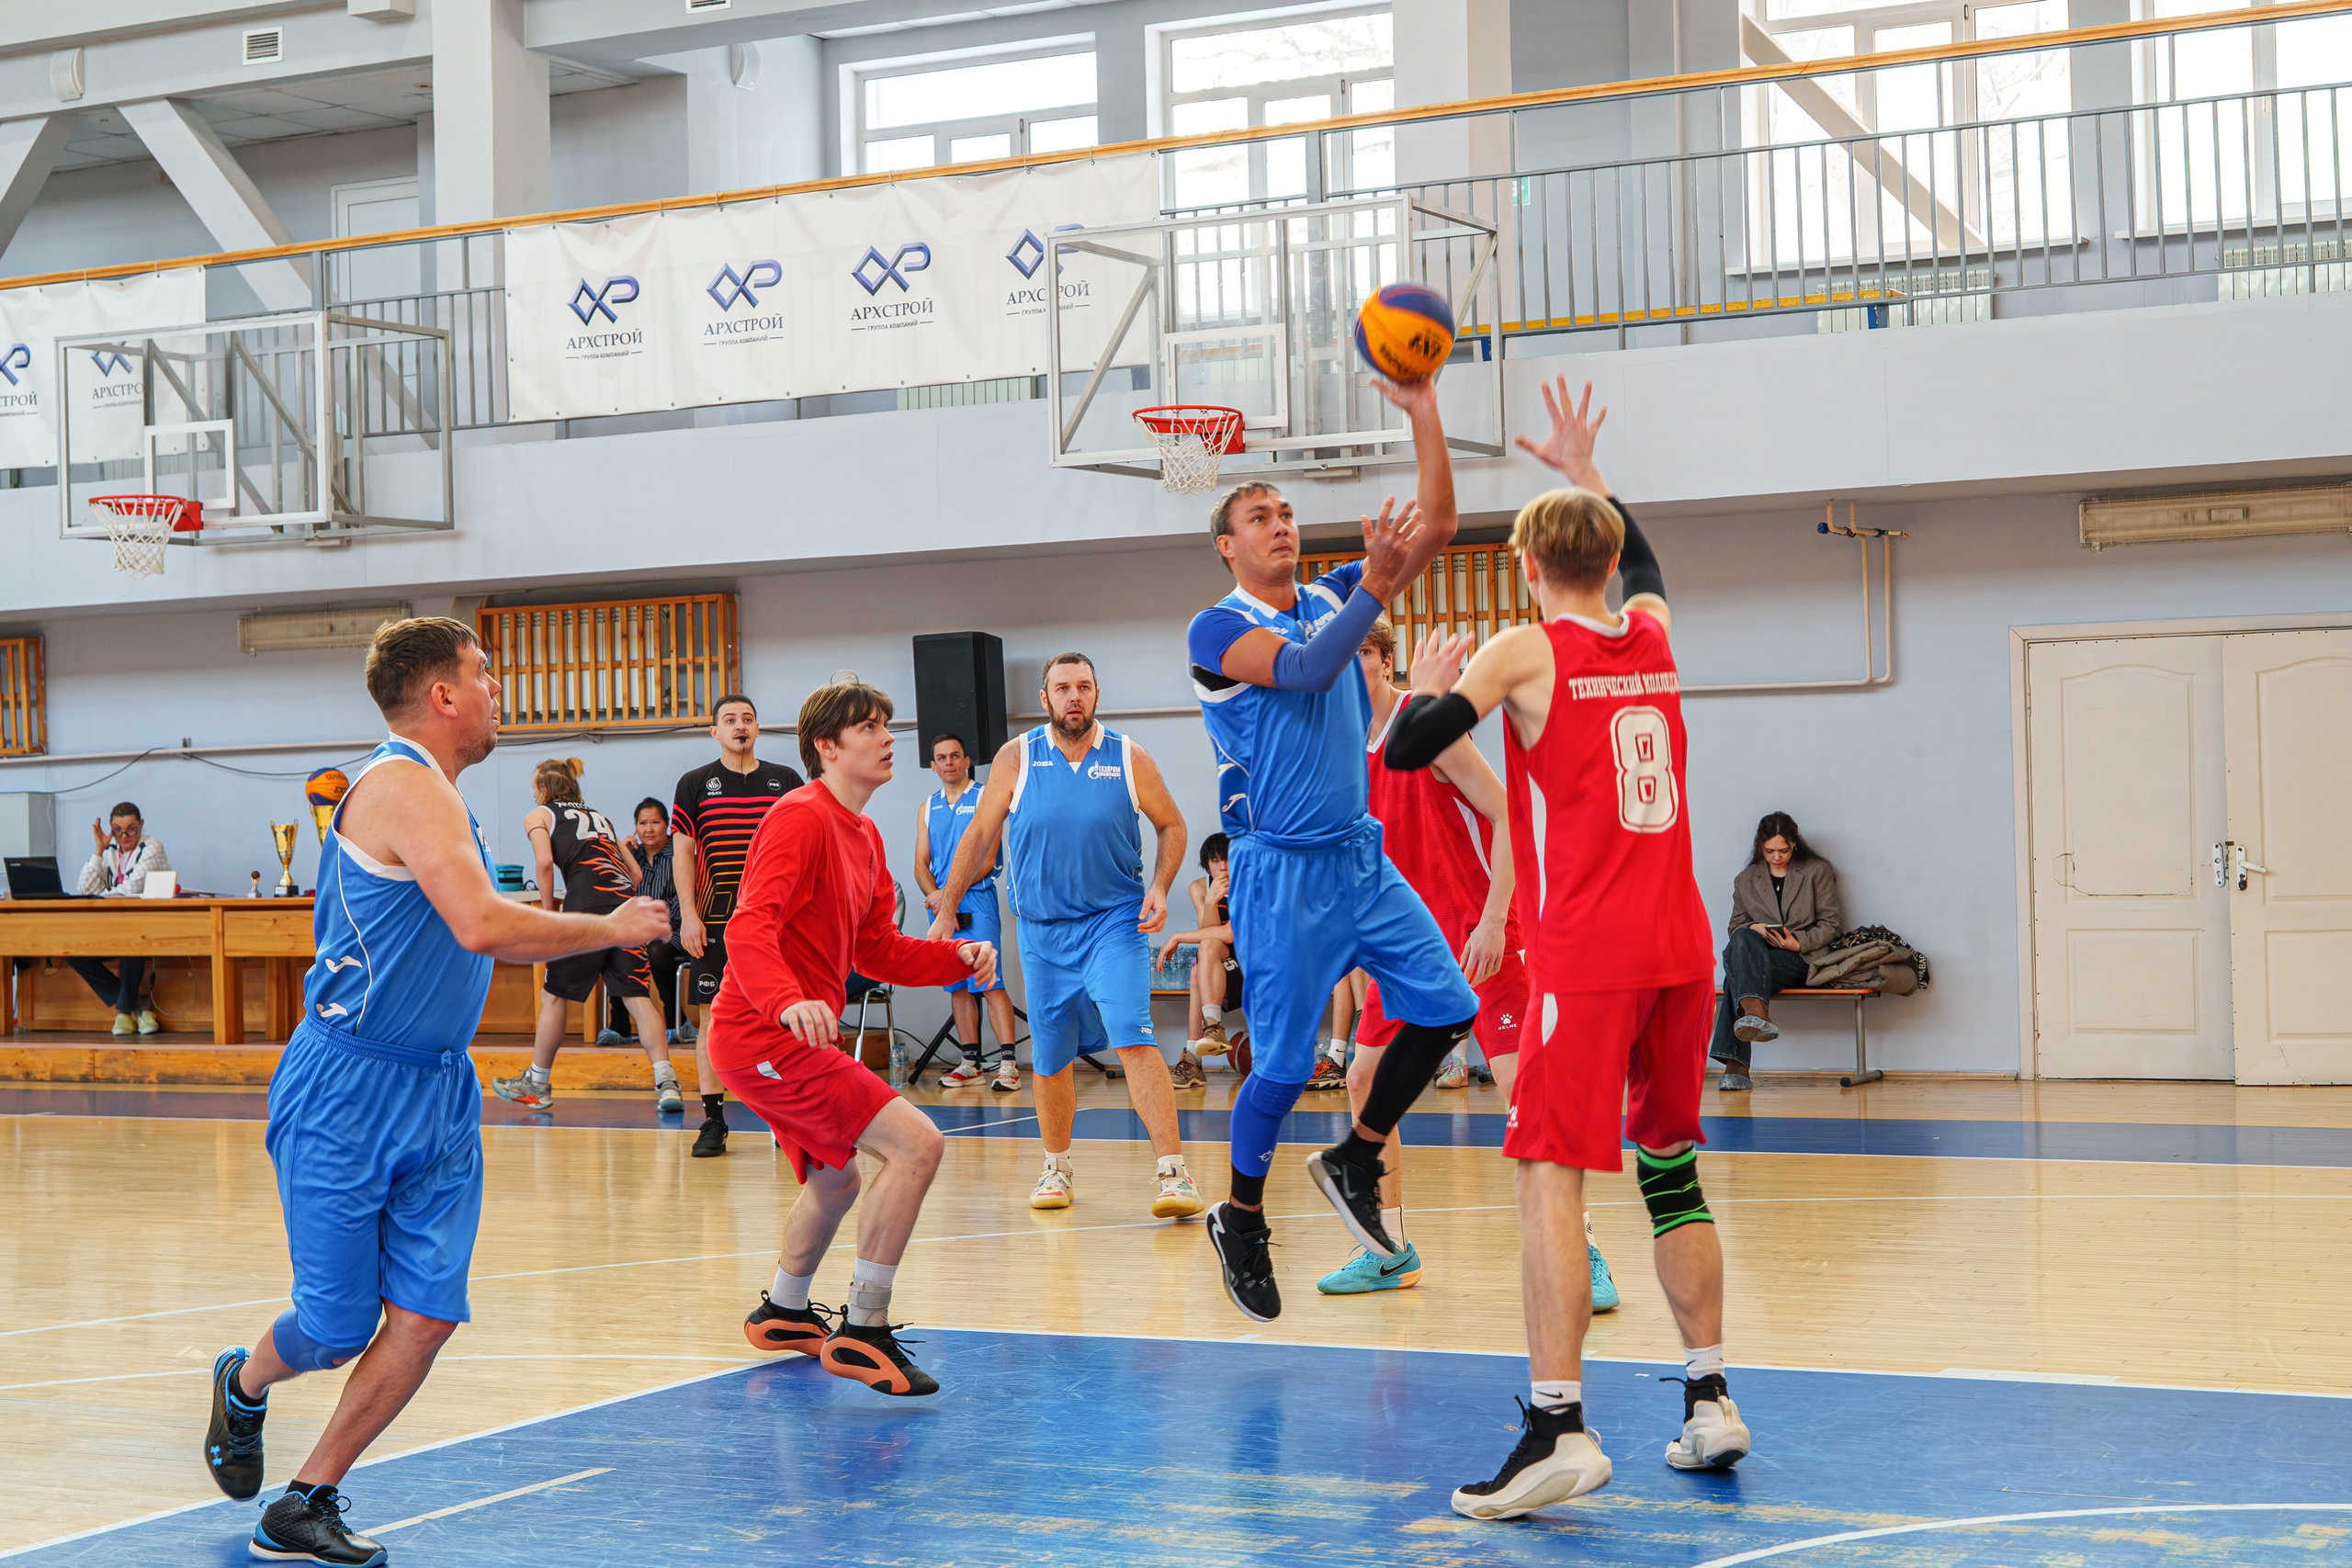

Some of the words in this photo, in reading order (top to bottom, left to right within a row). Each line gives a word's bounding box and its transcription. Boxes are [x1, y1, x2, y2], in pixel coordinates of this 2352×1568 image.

[1007, 279, 1090, 305] АРХСРОЙ
[851, 297, 933, 321] АРХСТРОЙ
[704, 312, 784, 335] АРХСТРОЙ
[889, 319, 919, 329] КОМПАНИЙ
[566, 328, 643, 349] АРХСТРОЙ
[0, 390, 38, 407] ТРОЙ
[92, 382, 143, 400] АРХСТРО
[1568, 670, 1645, 701] ТЕХНИЧЕСКИЙ
[1610, 705, 1679, 834] 8
[563, 808, 616, 843] 24
